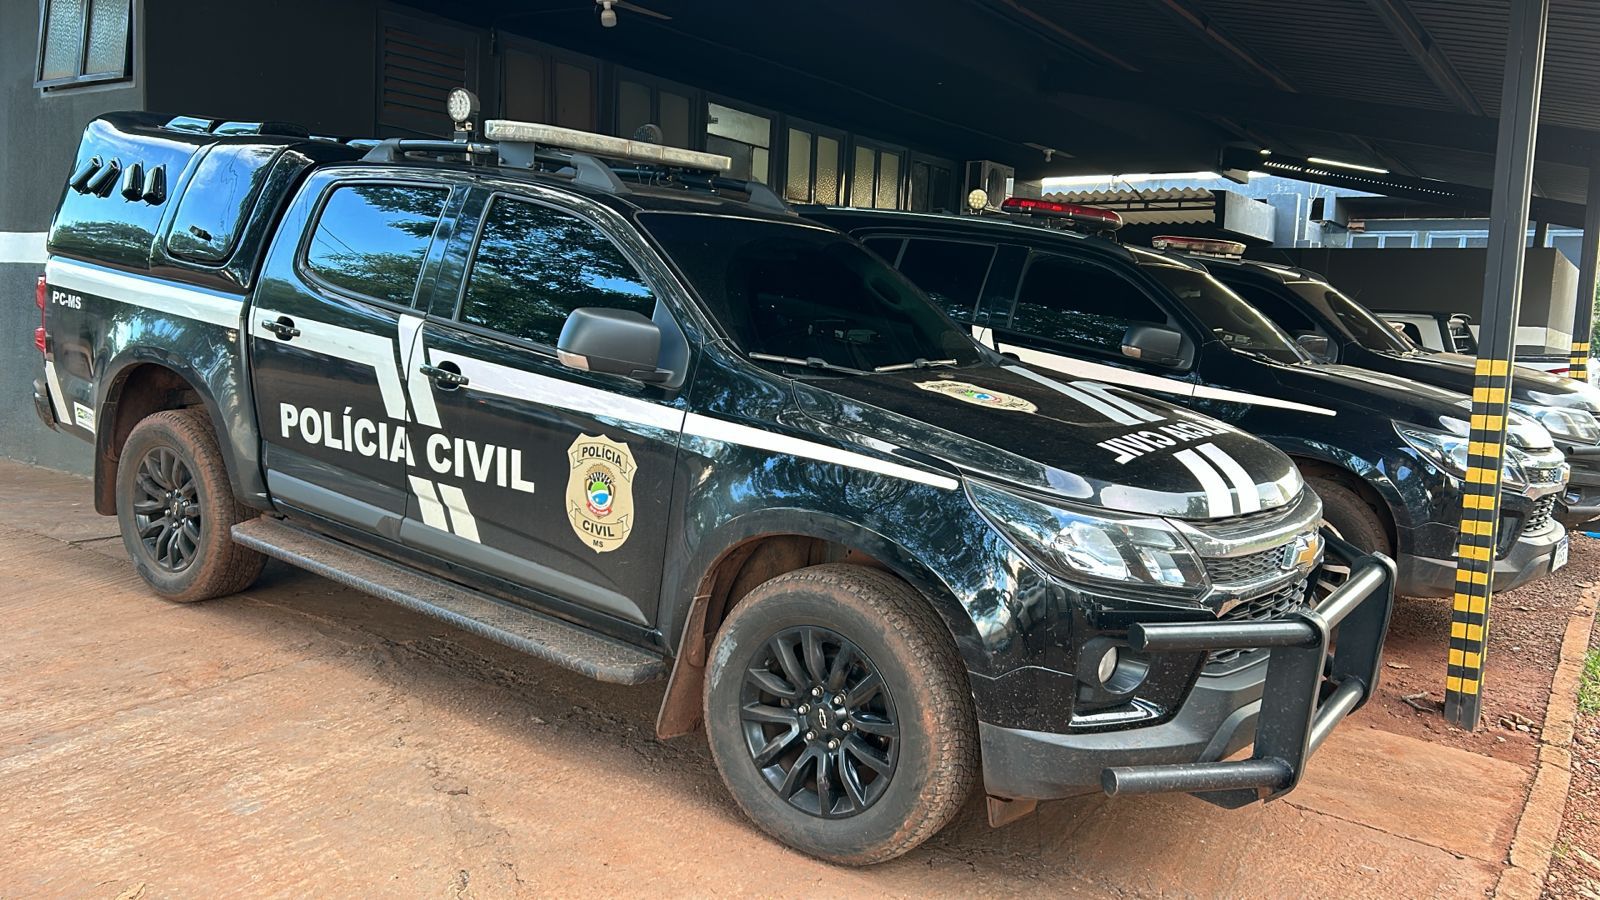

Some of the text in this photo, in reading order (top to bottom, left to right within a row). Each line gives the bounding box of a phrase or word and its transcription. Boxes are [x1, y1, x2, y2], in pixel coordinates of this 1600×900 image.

[52, 290, 82, 310] PC-MS
[279, 402, 535, 494] POLÍCIA CIVIL
[581, 445, 622, 467] POLÍCIA
[582, 520, 615, 537] CIVIL
[592, 539, 604, 548] MS
